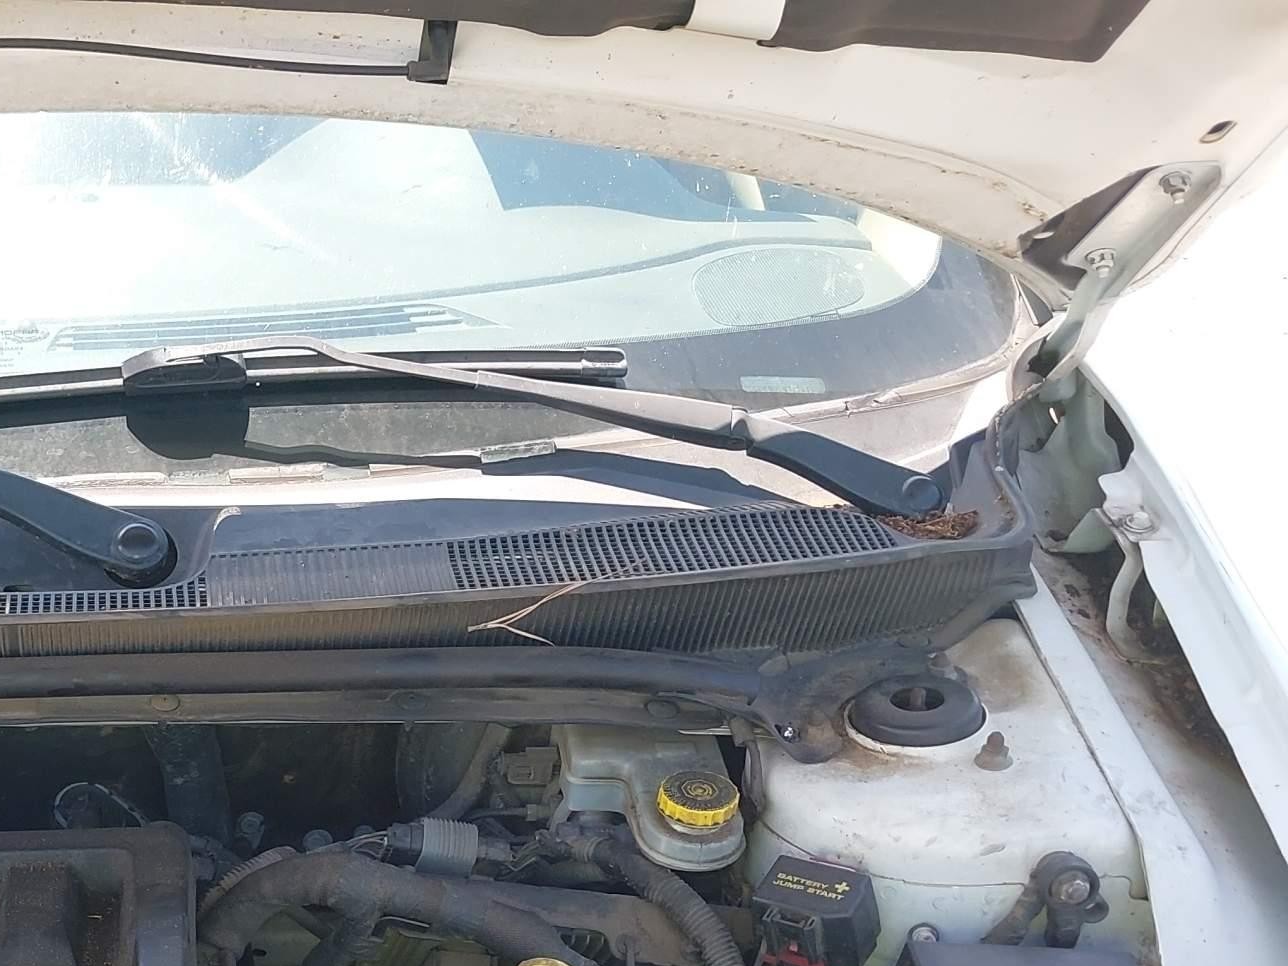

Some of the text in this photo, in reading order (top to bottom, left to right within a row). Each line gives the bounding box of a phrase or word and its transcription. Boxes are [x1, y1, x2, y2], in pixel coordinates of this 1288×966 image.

[776, 872, 829, 889] BATTERY
[772, 880, 845, 900] JUMP START
